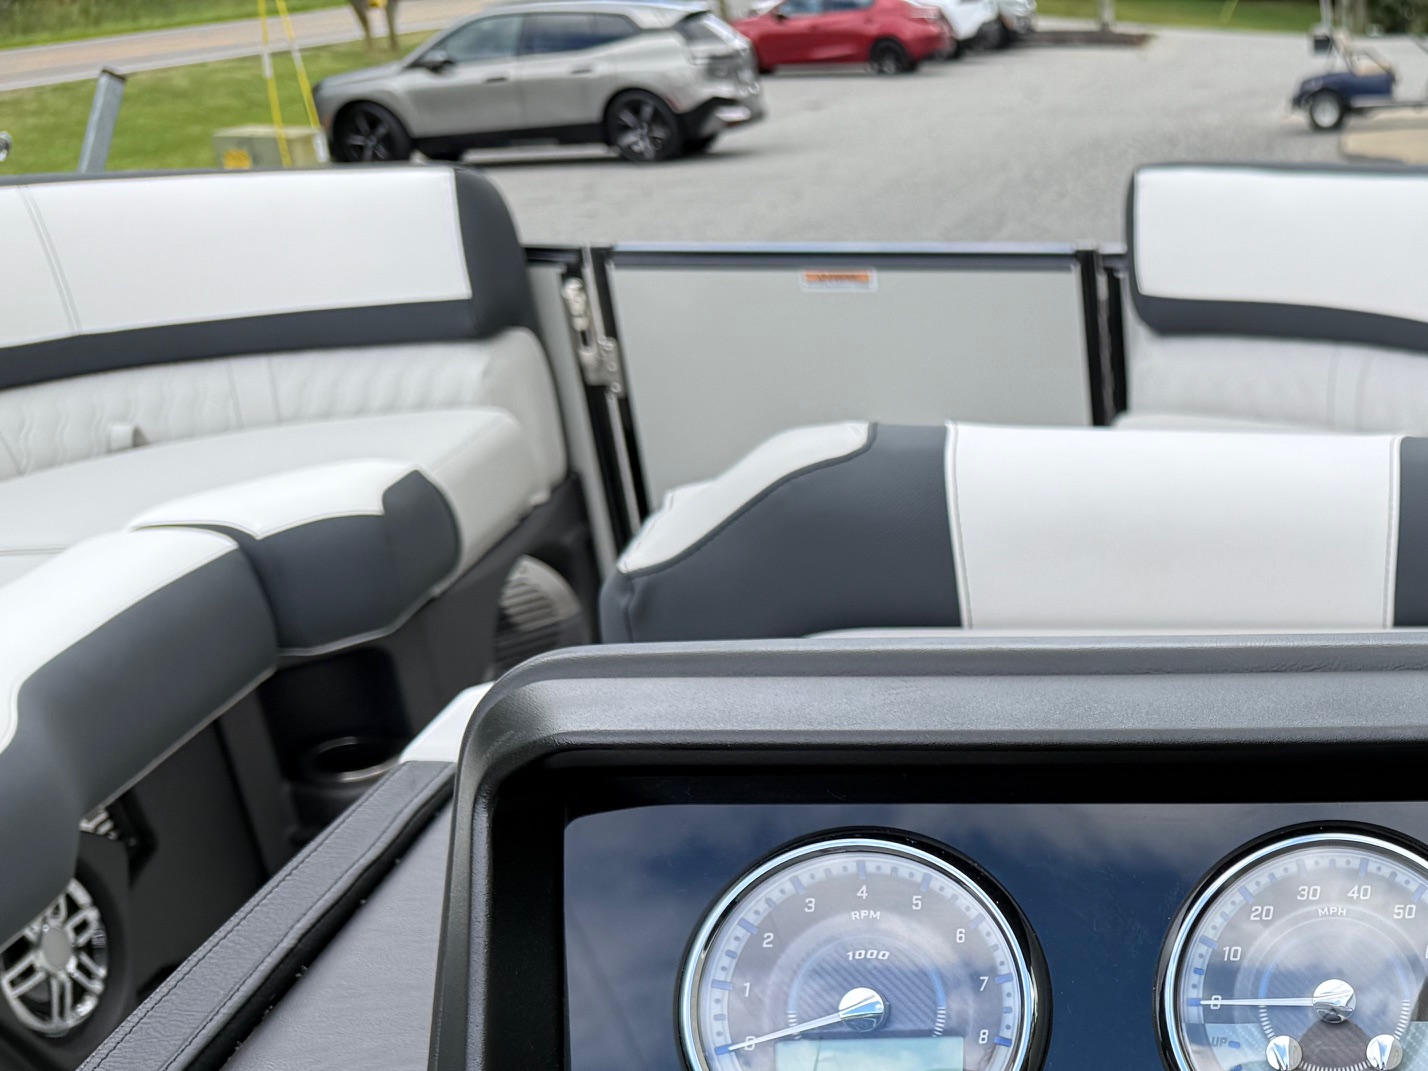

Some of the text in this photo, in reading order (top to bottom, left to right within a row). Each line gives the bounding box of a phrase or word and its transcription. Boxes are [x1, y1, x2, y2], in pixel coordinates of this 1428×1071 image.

[857, 885, 868, 899] 4
[1297, 886, 1321, 900] 30
[1347, 885, 1371, 900] 40
[805, 898, 816, 912] 3
[912, 896, 922, 910] 5
[851, 910, 881, 920] RPM
[1251, 906, 1274, 920] 20
[1318, 907, 1347, 917] MPH
[1393, 905, 1416, 919] 50
[762, 933, 774, 947] 2
[956, 929, 966, 943] 6
[847, 950, 890, 961] 1000
[1223, 947, 1242, 961] 10
[744, 982, 751, 997] 1
[979, 977, 989, 991] 7
[1210, 995, 1222, 1009] 0
[979, 1030, 989, 1044] 8
[1212, 1037, 1228, 1047] UP
